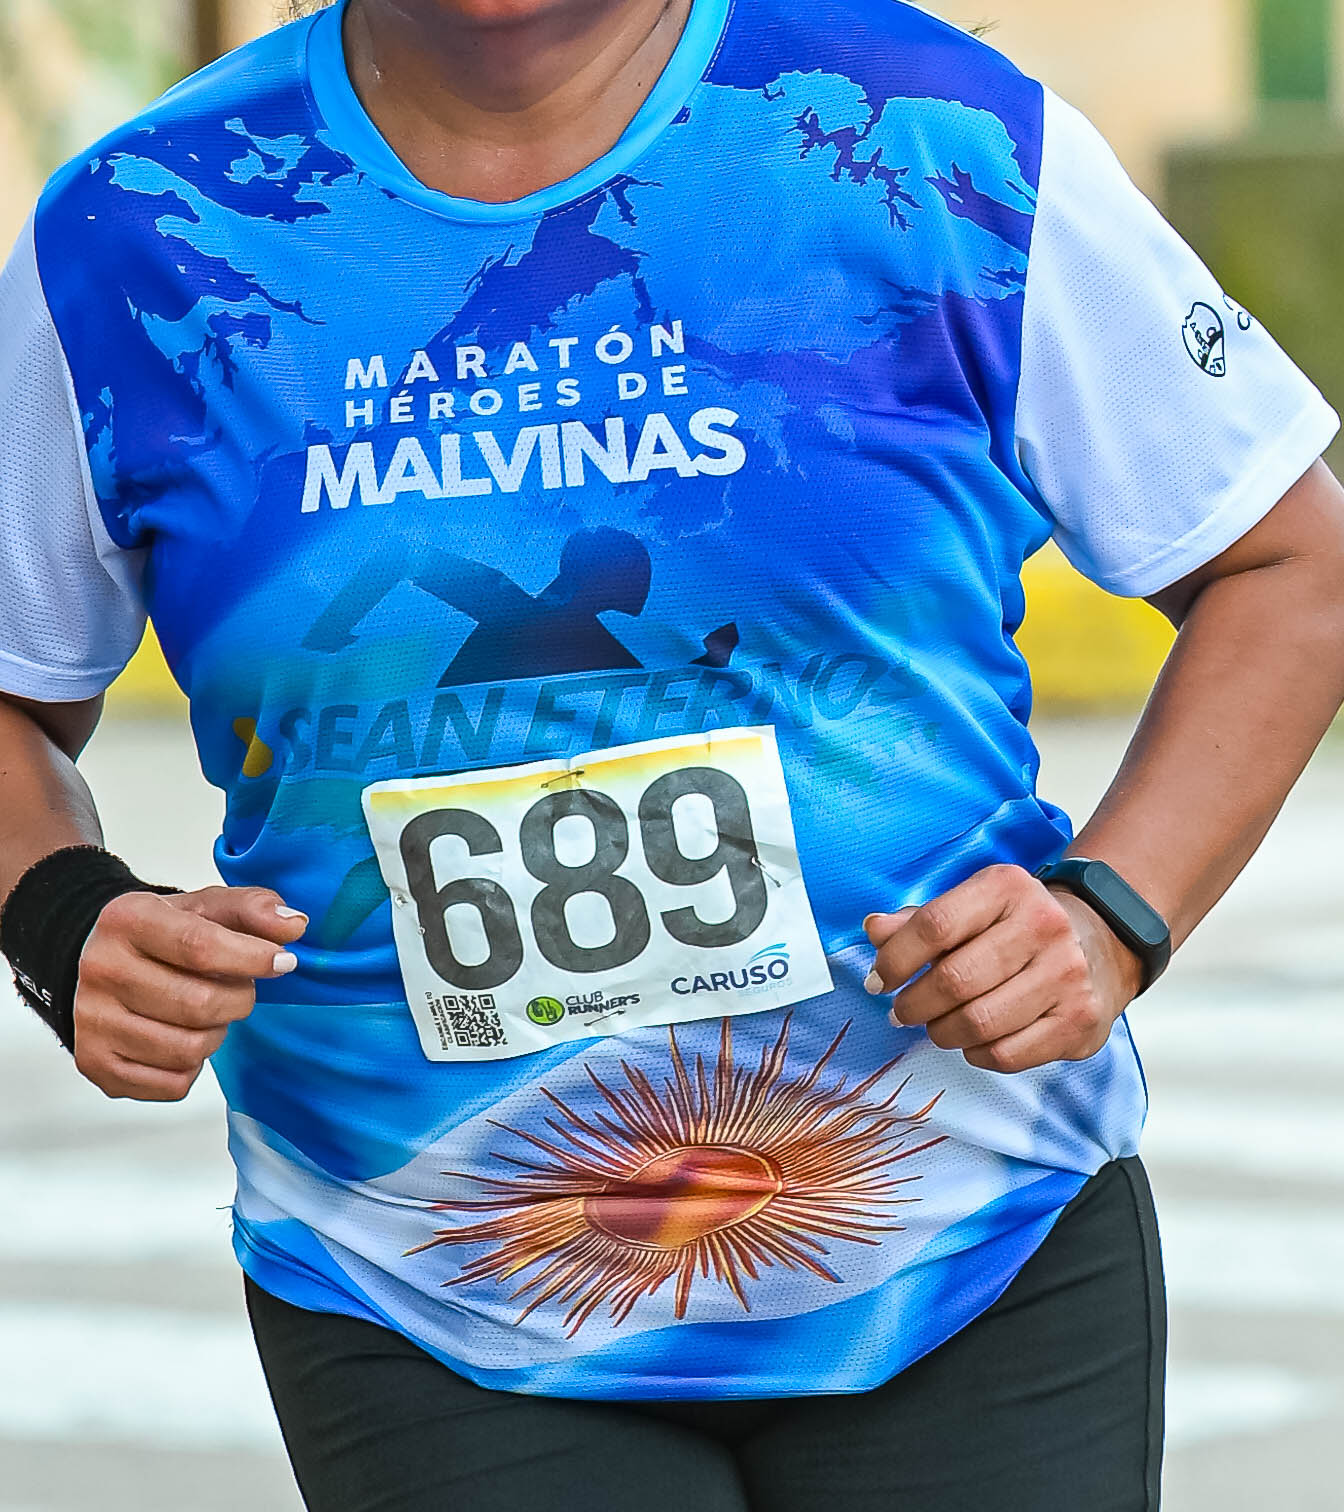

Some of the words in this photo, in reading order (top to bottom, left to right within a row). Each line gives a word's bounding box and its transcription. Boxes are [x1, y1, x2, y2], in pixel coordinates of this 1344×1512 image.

[344, 320, 686, 390] MARATÓN
[345, 378, 581, 428] HÉROES
[618, 365, 689, 401] DE
[300, 407, 748, 513] MALVINAS
[279, 687, 505, 778] SEAN
[399, 766, 769, 990] 689
[565, 990, 604, 1006] CLUB
[567, 993, 641, 1017] RUNNER'S
[670, 958, 790, 996] CARUSO
